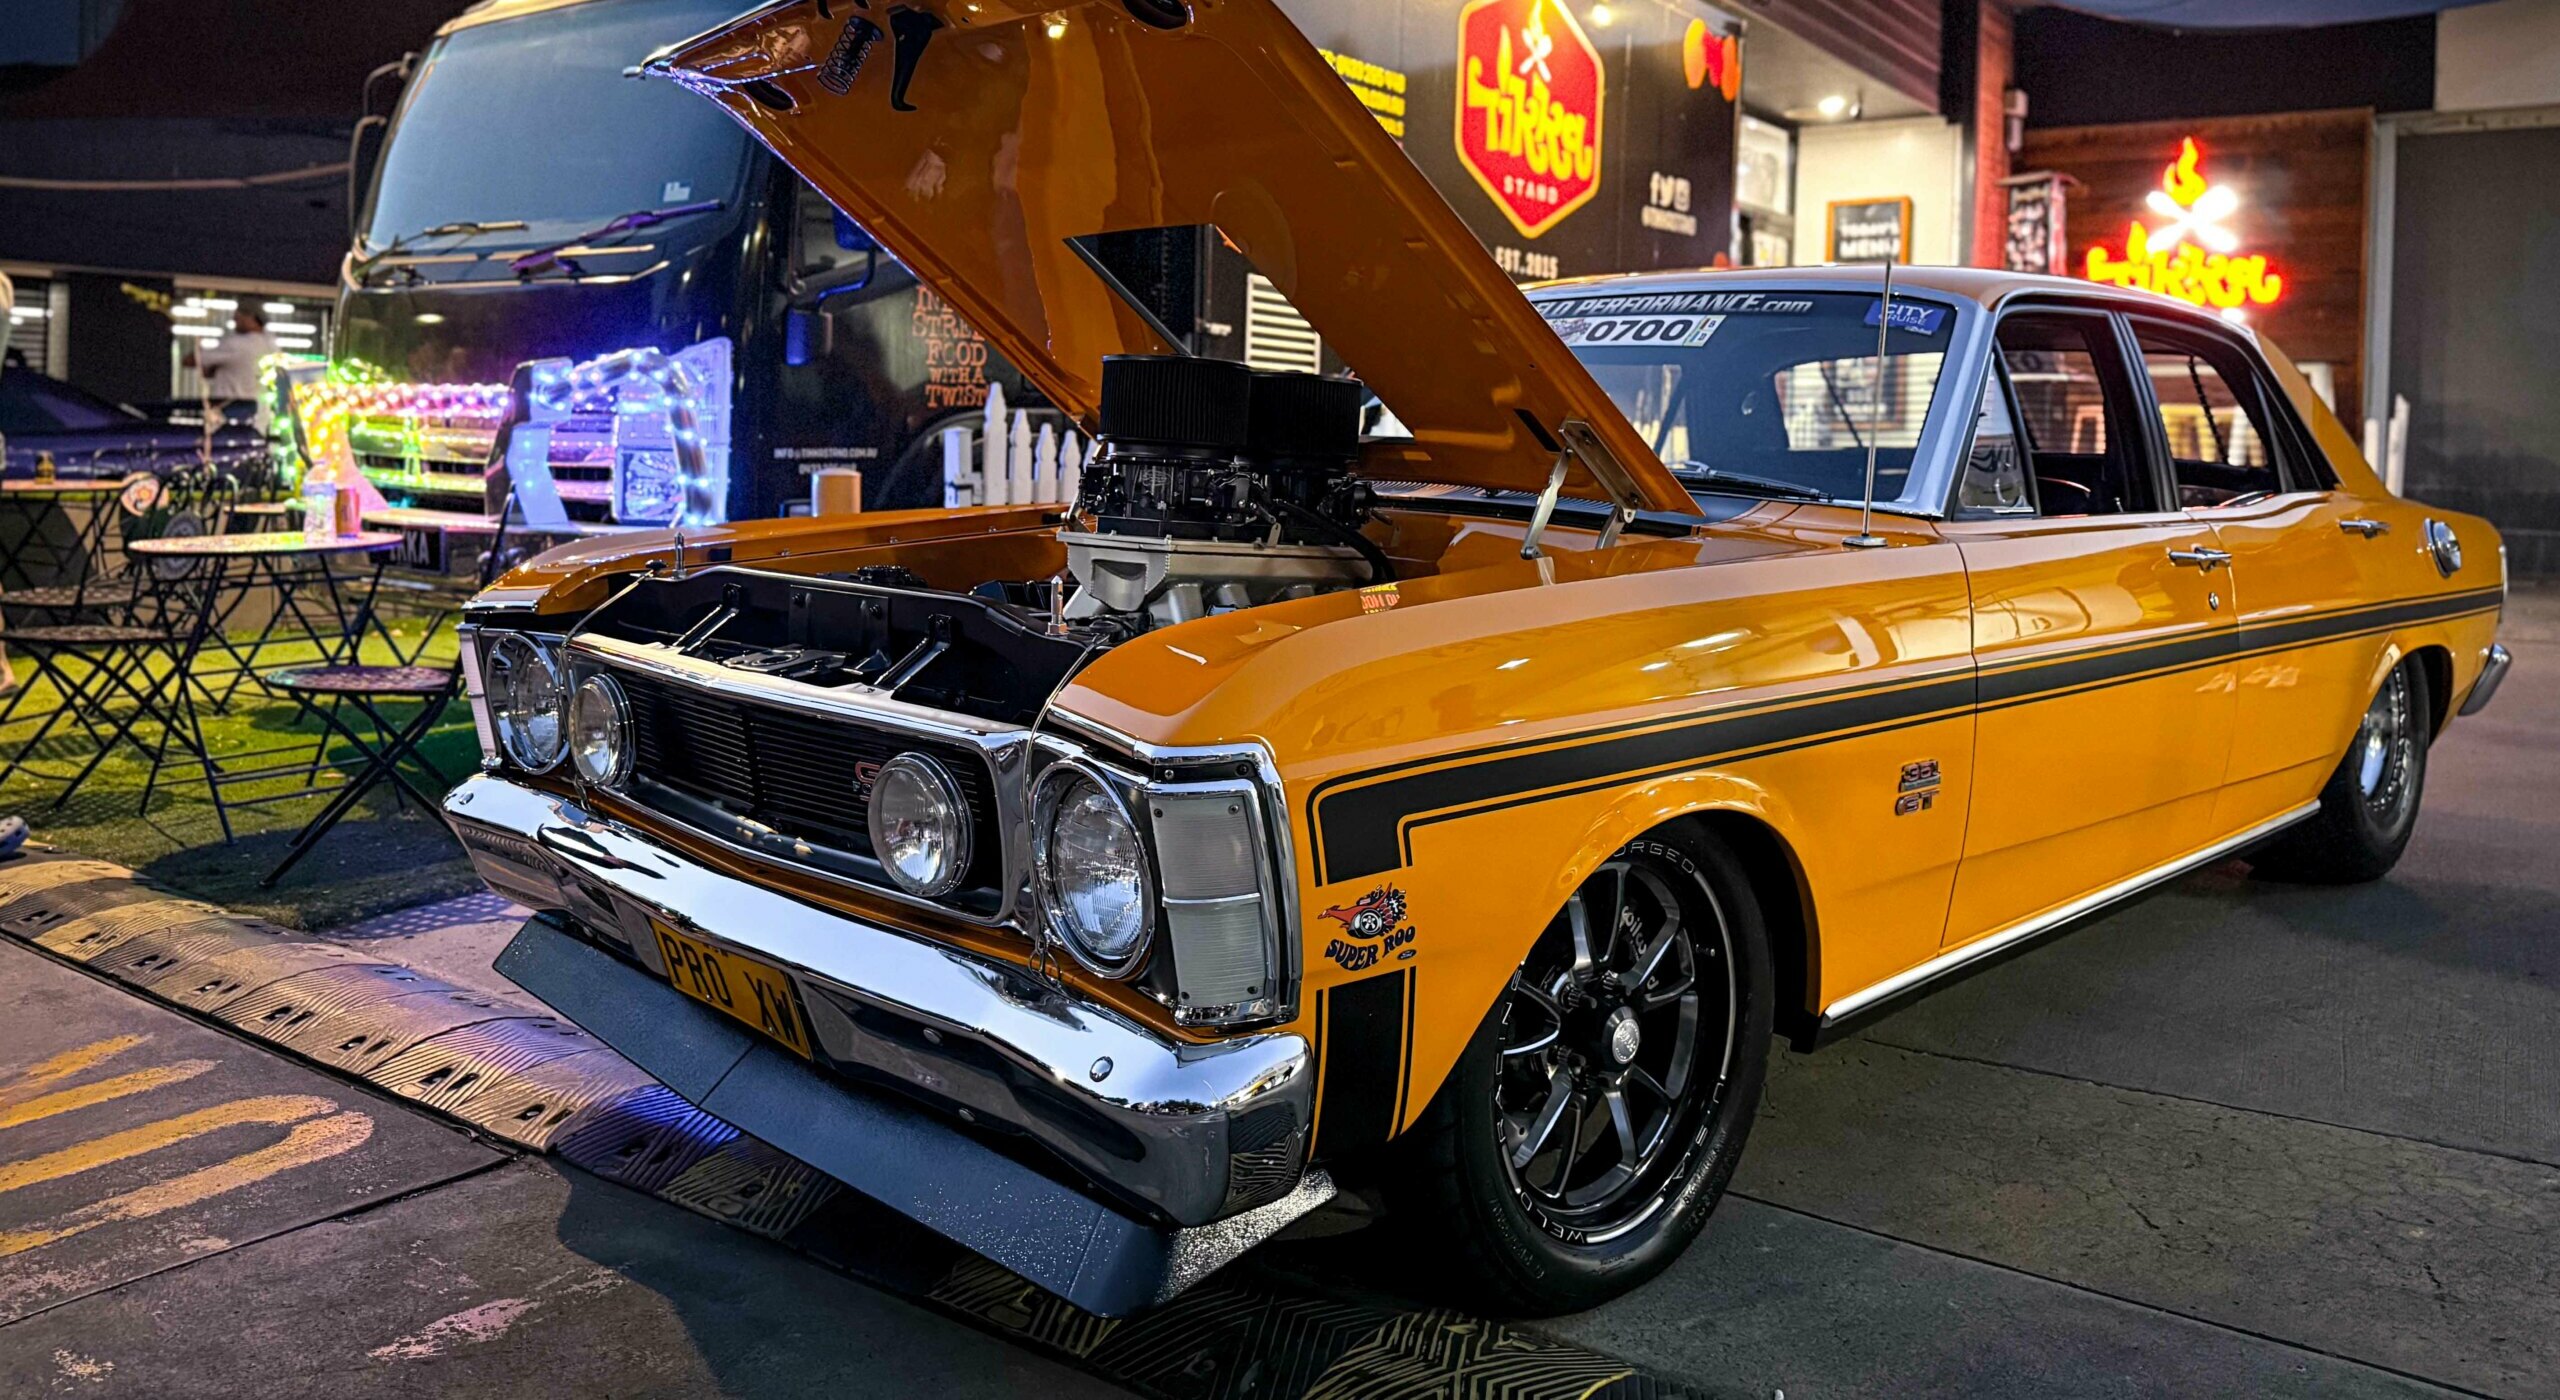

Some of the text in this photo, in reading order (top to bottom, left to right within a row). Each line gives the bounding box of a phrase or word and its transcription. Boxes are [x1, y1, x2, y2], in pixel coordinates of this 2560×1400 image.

[1503, 175, 1559, 205] STAND
[1586, 319, 1694, 342] 0700
[928, 366, 988, 384] WITH A
[925, 385, 989, 408] TWIST
[1895, 790, 1939, 816] GT
[1324, 926, 1416, 972] SUPER ROO
[660, 931, 800, 1047] PRO XW
[1520, 1191, 1585, 1244] WELD
